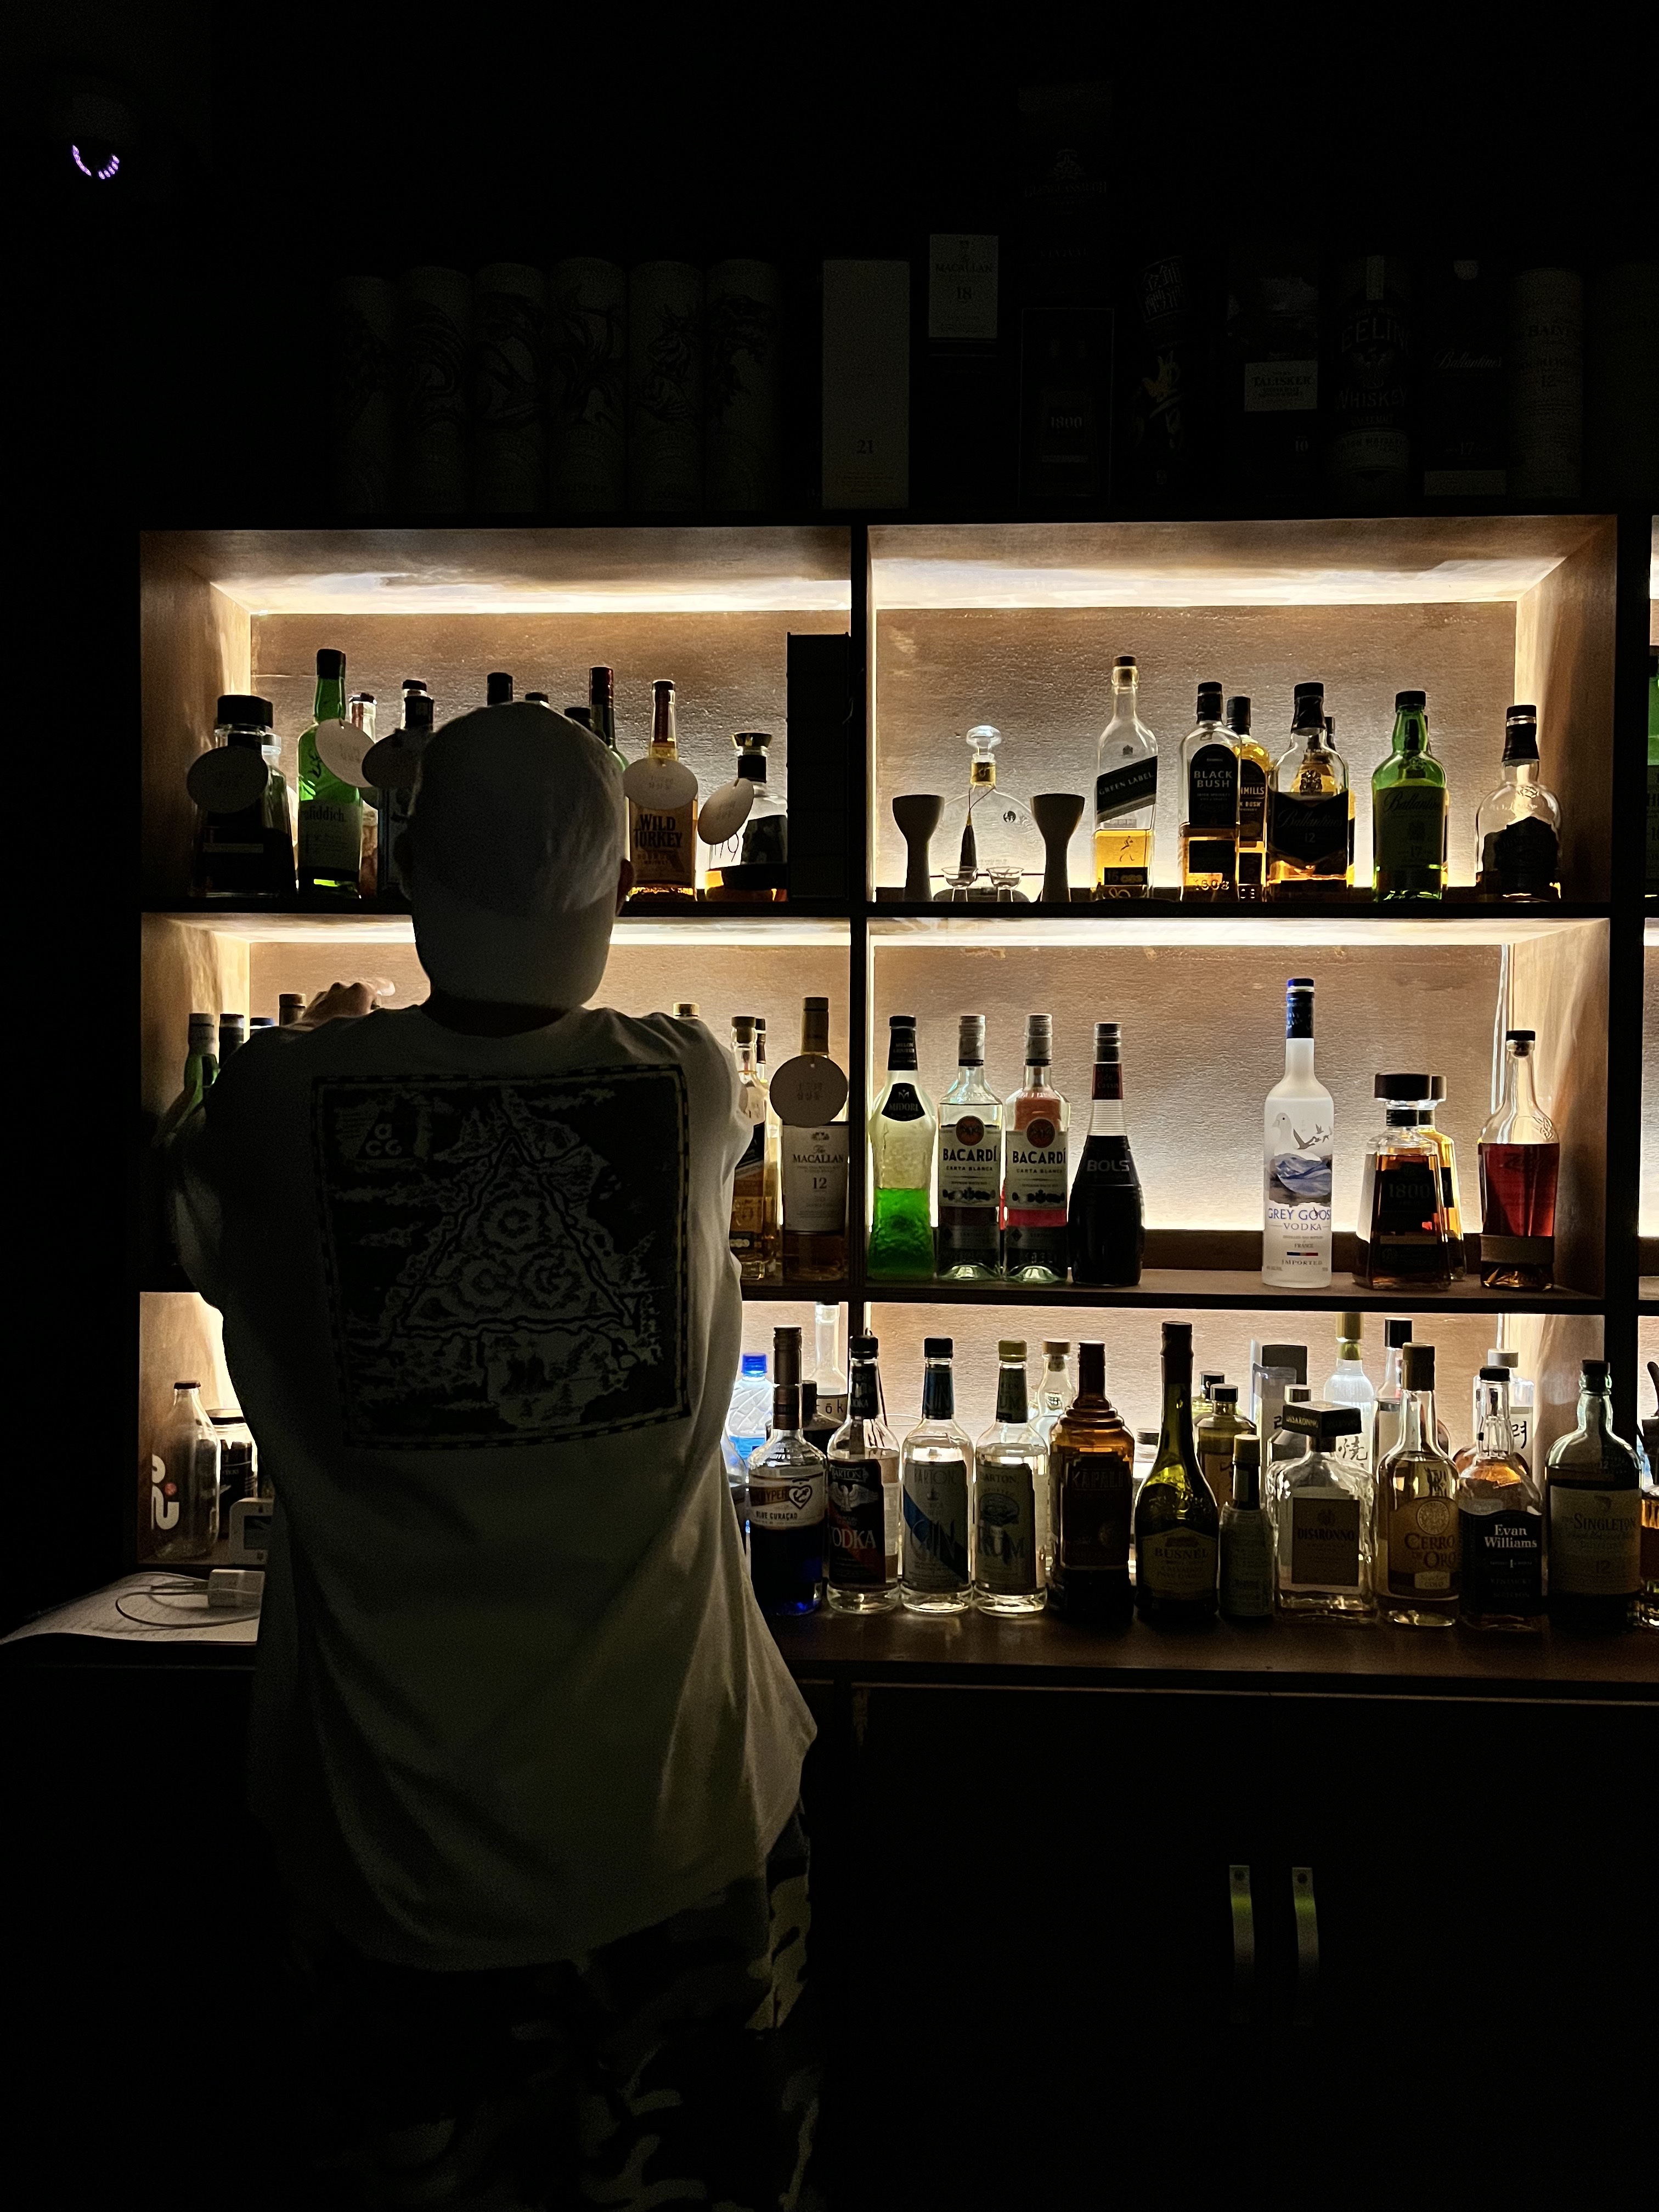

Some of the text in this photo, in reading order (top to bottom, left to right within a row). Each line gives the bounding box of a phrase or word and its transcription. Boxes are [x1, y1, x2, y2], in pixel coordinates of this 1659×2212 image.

[935, 263, 994, 273] MACALLAN
[956, 286, 972, 300] 18
[1252, 376, 1311, 387] TALISKER
[1050, 416, 1084, 430] 1800
[857, 439, 874, 454] 21
[1295, 439, 1310, 452] 10
[1460, 441, 1475, 455] 17
[1194, 770, 1233, 779] BLACK
[1098, 771, 1154, 795] GREEN LABEL
[1197, 780, 1230, 788] BUSH
[640, 814, 676, 831] WILD
[634, 828, 682, 849] TURKEY
[1304, 832, 1317, 844] 12
[888, 1102, 919, 1112] MIDORI
[792, 1154, 844, 1164] MACALLAN
[943, 1145, 997, 1162] BACARDÍ
[1086, 1159, 1131, 1172] BOLS
[812, 1177, 827, 1189] 12
[1388, 1183, 1431, 1199] 1800
[1268, 1207, 1330, 1220] GREY GOOS
[1283, 1222, 1322, 1231] VODKA
[1286, 1415, 1319, 1429] DISARONNO
[831, 1467, 862, 1479] BARTON
[914, 1468, 956, 1485] BARTON
[980, 1472, 1019, 1484] BARTON
[770, 1512, 798, 1521] CURAÇAO
[1574, 1513, 1636, 1531] SINGLETON
[1297, 1528, 1355, 1542] DISARONNO
[1494, 1523, 1528, 1536] Evan
[910, 1519, 956, 1562] GIN
[978, 1525, 1027, 1561] RUM
[1404, 1532, 1455, 1550] CERRO
[1483, 1536, 1538, 1549] Williams
[1154, 1547, 1209, 1560] BUSNEL
[1424, 1550, 1457, 1569] ORO
[1595, 1560, 1612, 1574] 12
